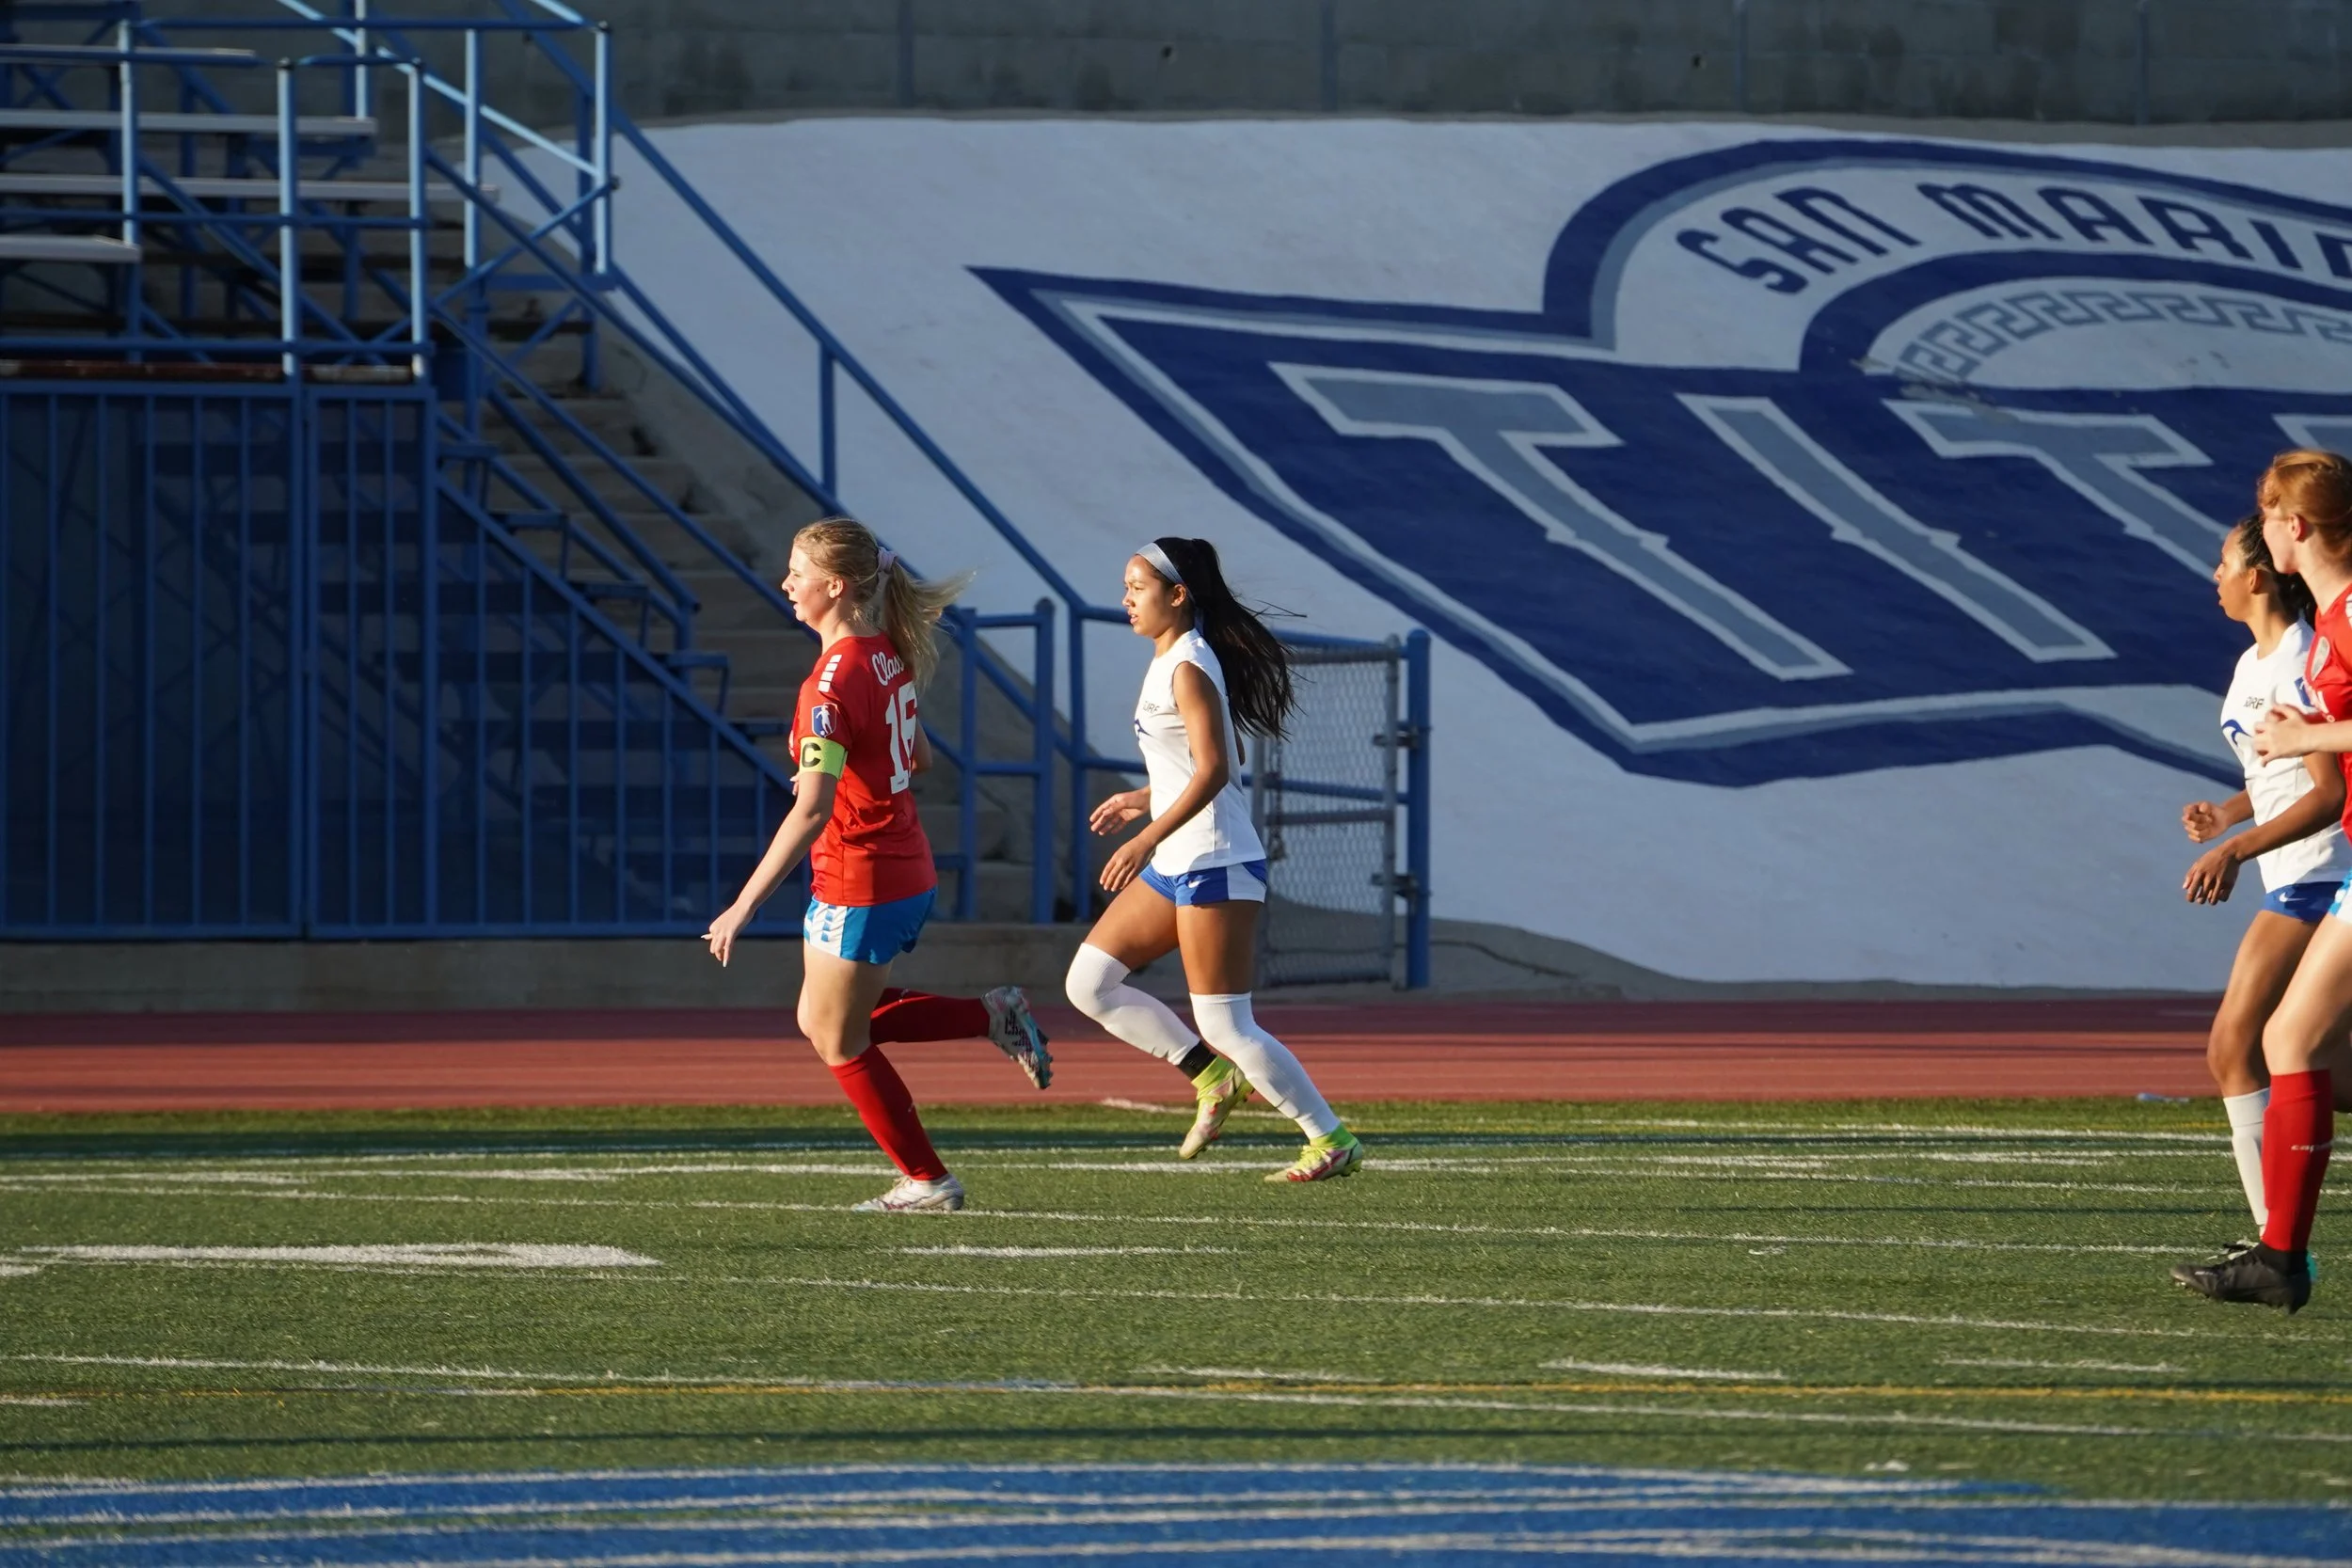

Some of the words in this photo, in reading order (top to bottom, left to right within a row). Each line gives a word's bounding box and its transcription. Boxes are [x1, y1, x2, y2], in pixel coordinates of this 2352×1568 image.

[1676, 186, 1922, 294] SAN
[1267, 362, 2352, 682] TIT
[803, 742, 821, 768] C
